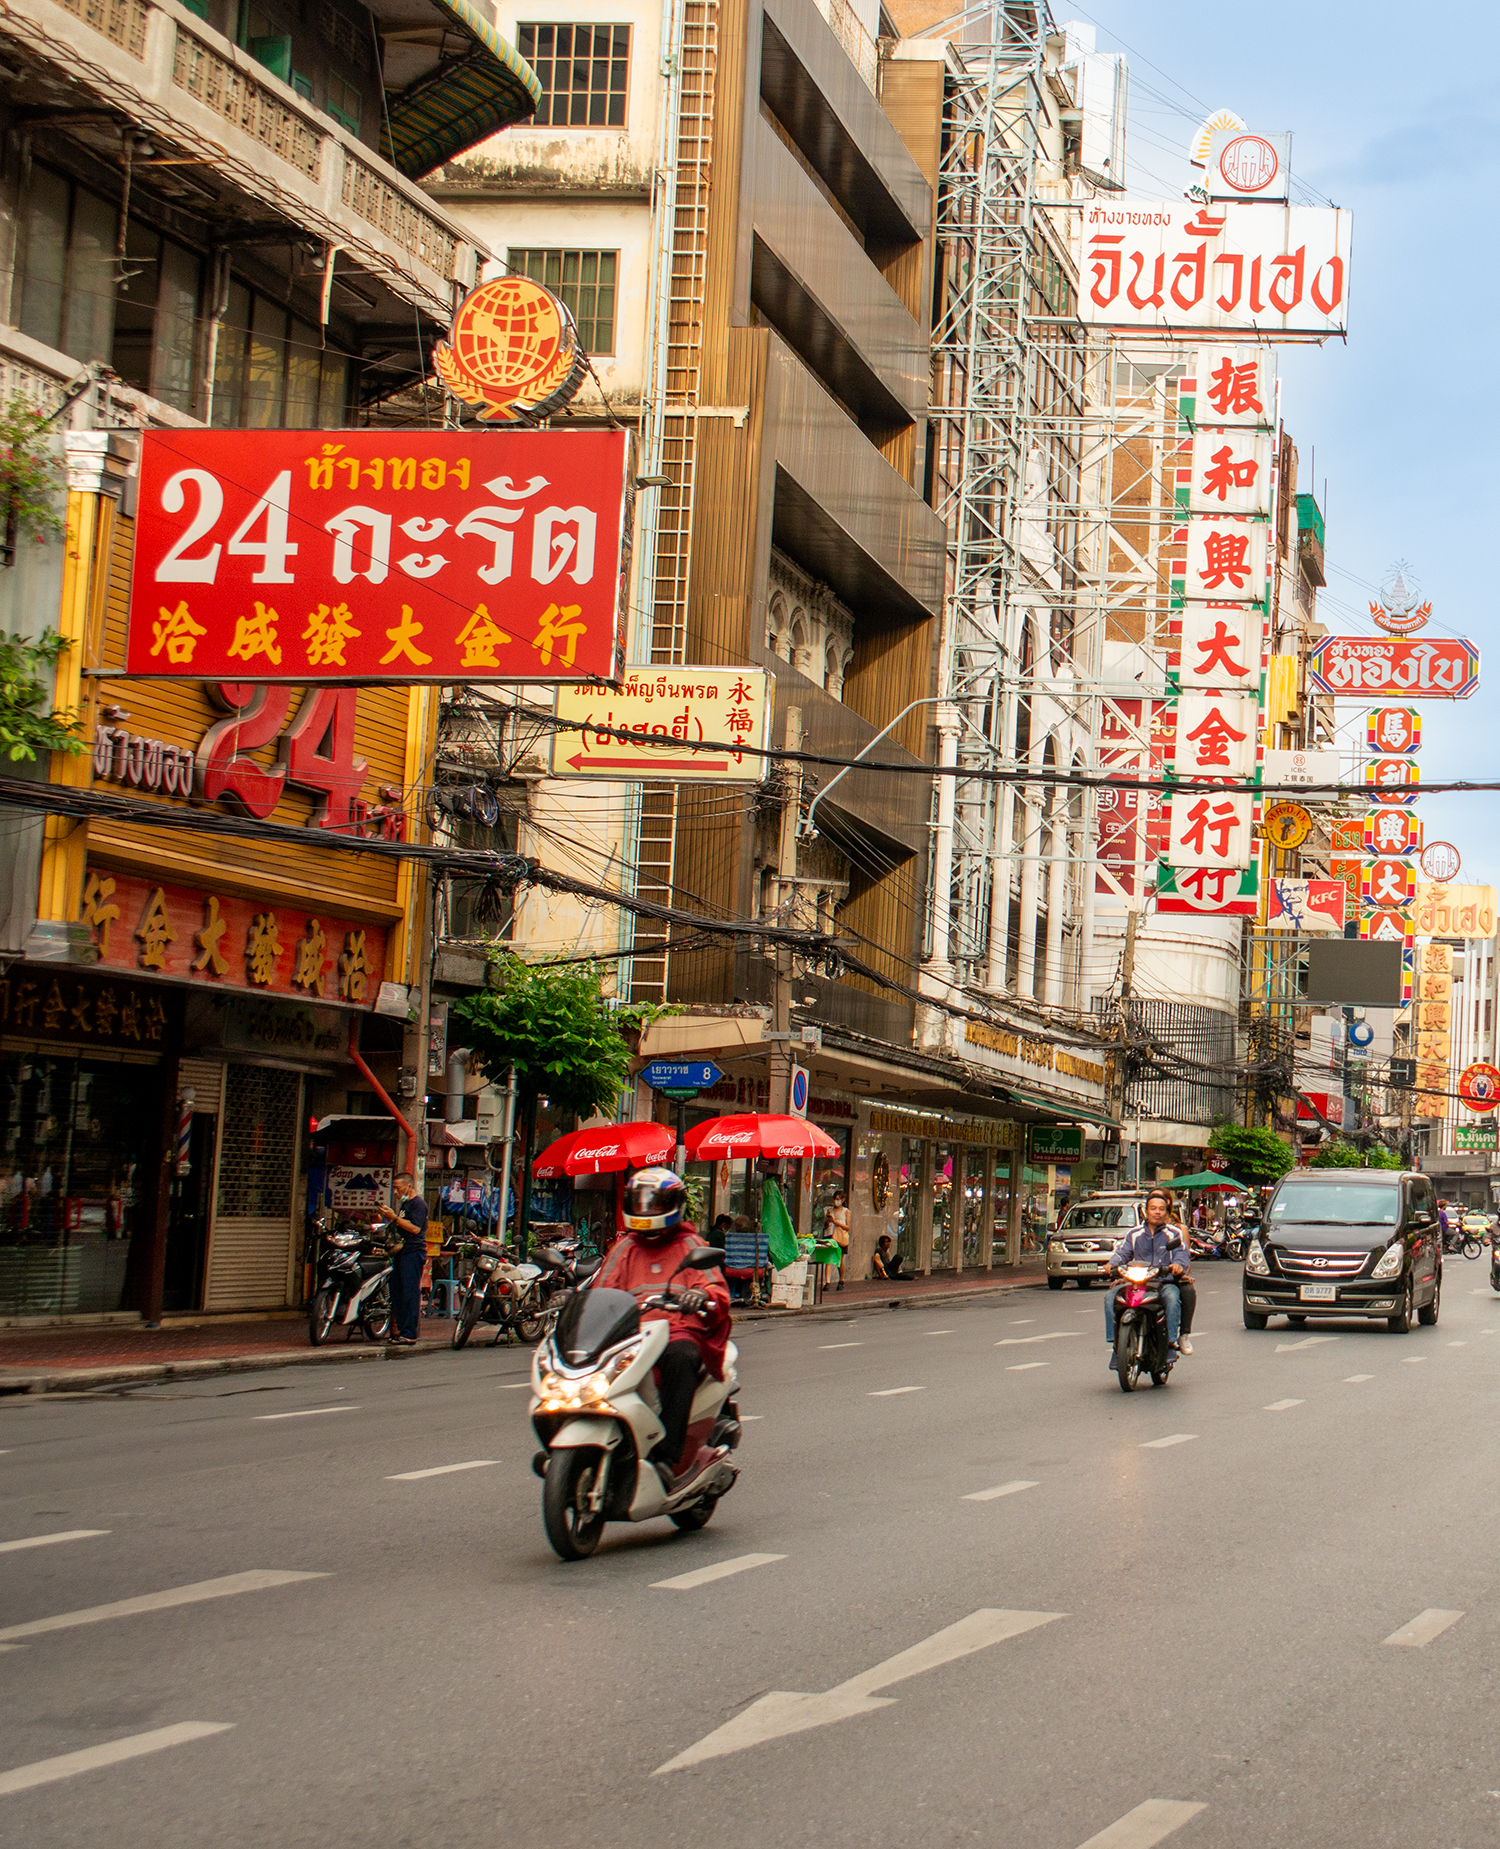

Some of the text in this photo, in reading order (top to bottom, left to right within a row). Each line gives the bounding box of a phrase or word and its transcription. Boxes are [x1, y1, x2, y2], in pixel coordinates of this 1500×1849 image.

[1088, 207, 1171, 227] ห้างขายทอง
[304, 443, 471, 491] ห้างทอง
[155, 468, 598, 586] 24 กะรัต
[1180, 356, 1263, 858] 振和興大金行
[150, 602, 588, 669] 洽成發大金行
[1330, 640, 1394, 658] ห้างทอง
[1310, 890, 1338, 906] KFC
[651, 1066, 711, 1080] เยาวราช 8
[709, 1132, 754, 1144] Coca-Cola
[574, 1145, 621, 1160] Coca-Cola
[778, 1145, 805, 1156] Coca-Cola
